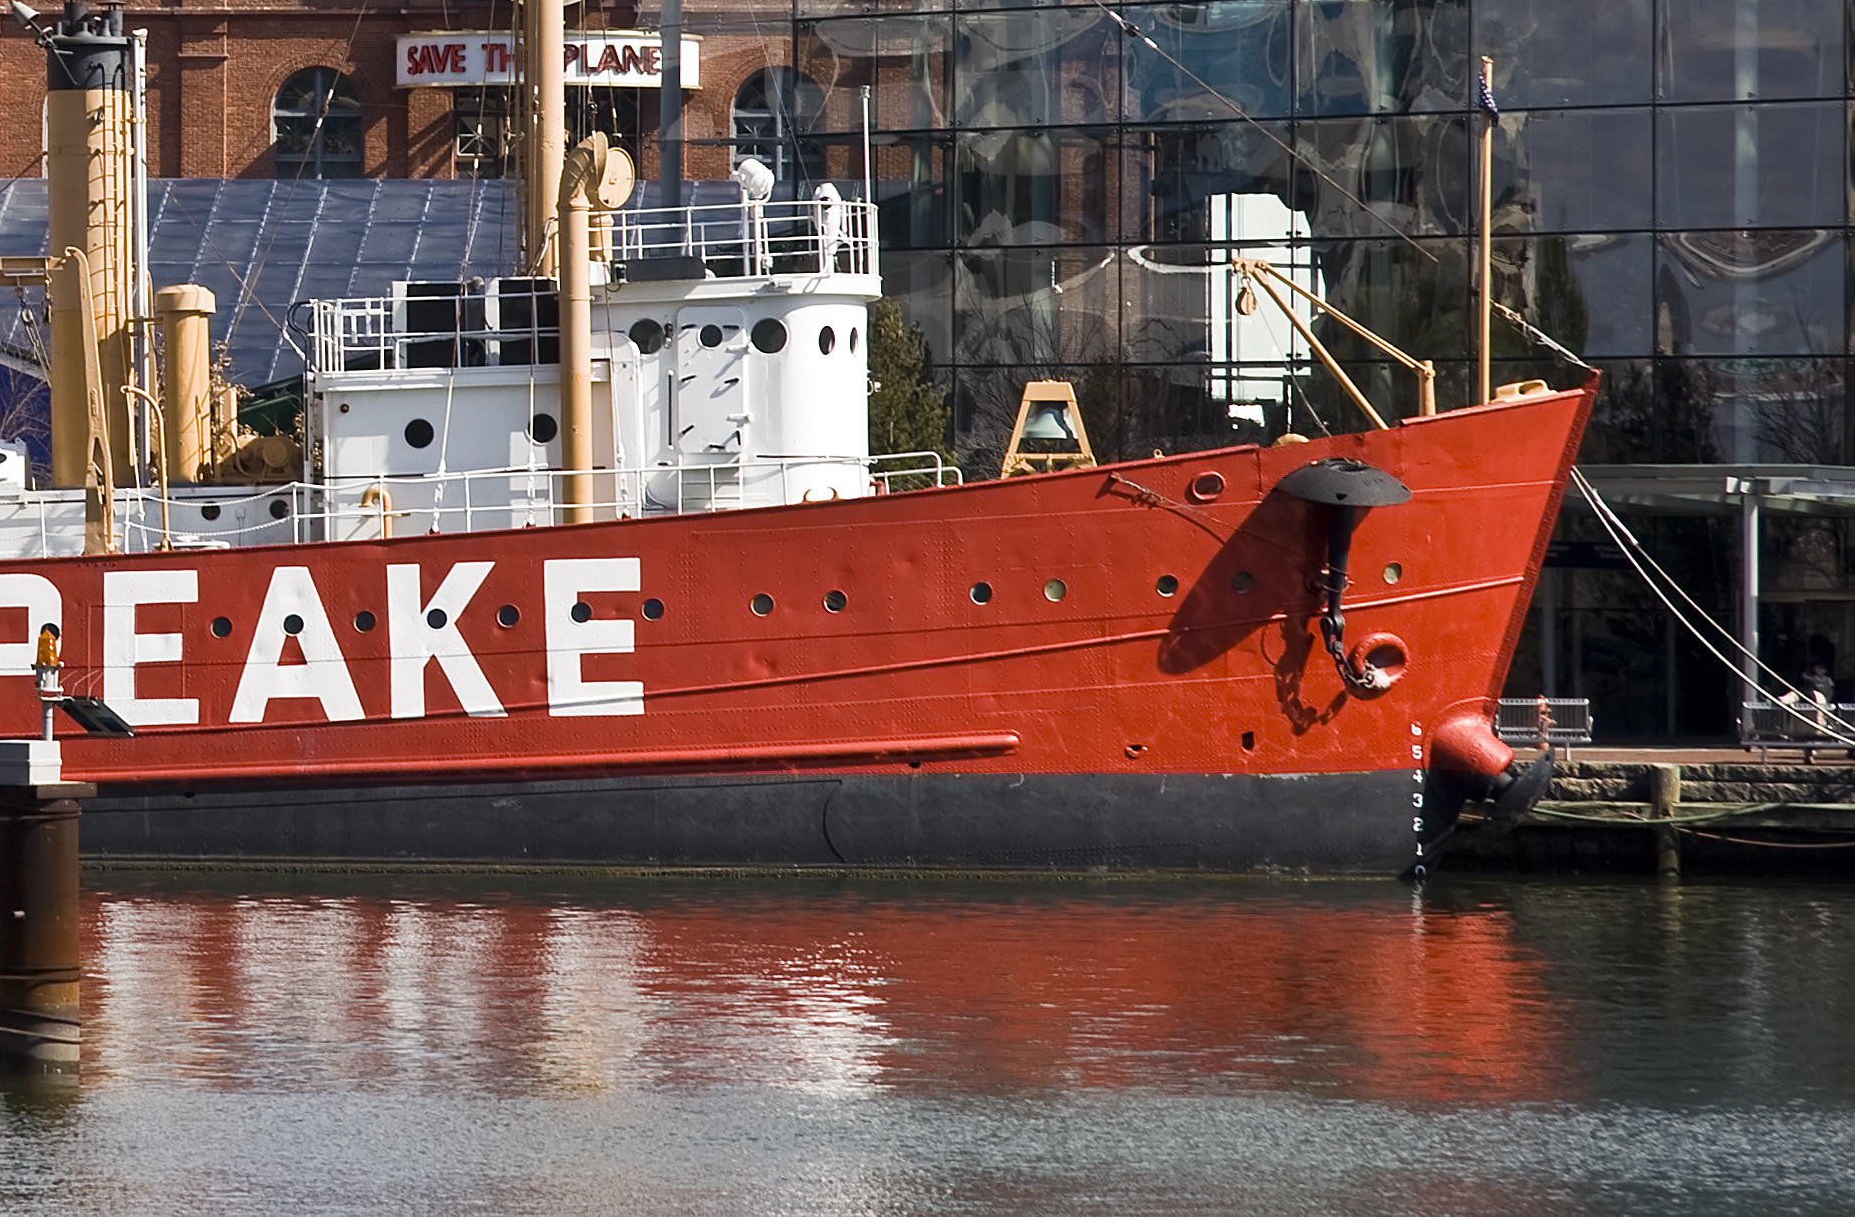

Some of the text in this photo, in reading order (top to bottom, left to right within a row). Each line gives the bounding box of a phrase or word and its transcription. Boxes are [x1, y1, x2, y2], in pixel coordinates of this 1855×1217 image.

[407, 43, 662, 76] SAVE TH PLANE
[1412, 745, 1423, 760] 5
[1412, 769, 1424, 784] 4
[1412, 792, 1424, 808] 3
[1413, 817, 1424, 832] 2
[1416, 842, 1424, 856] 1
